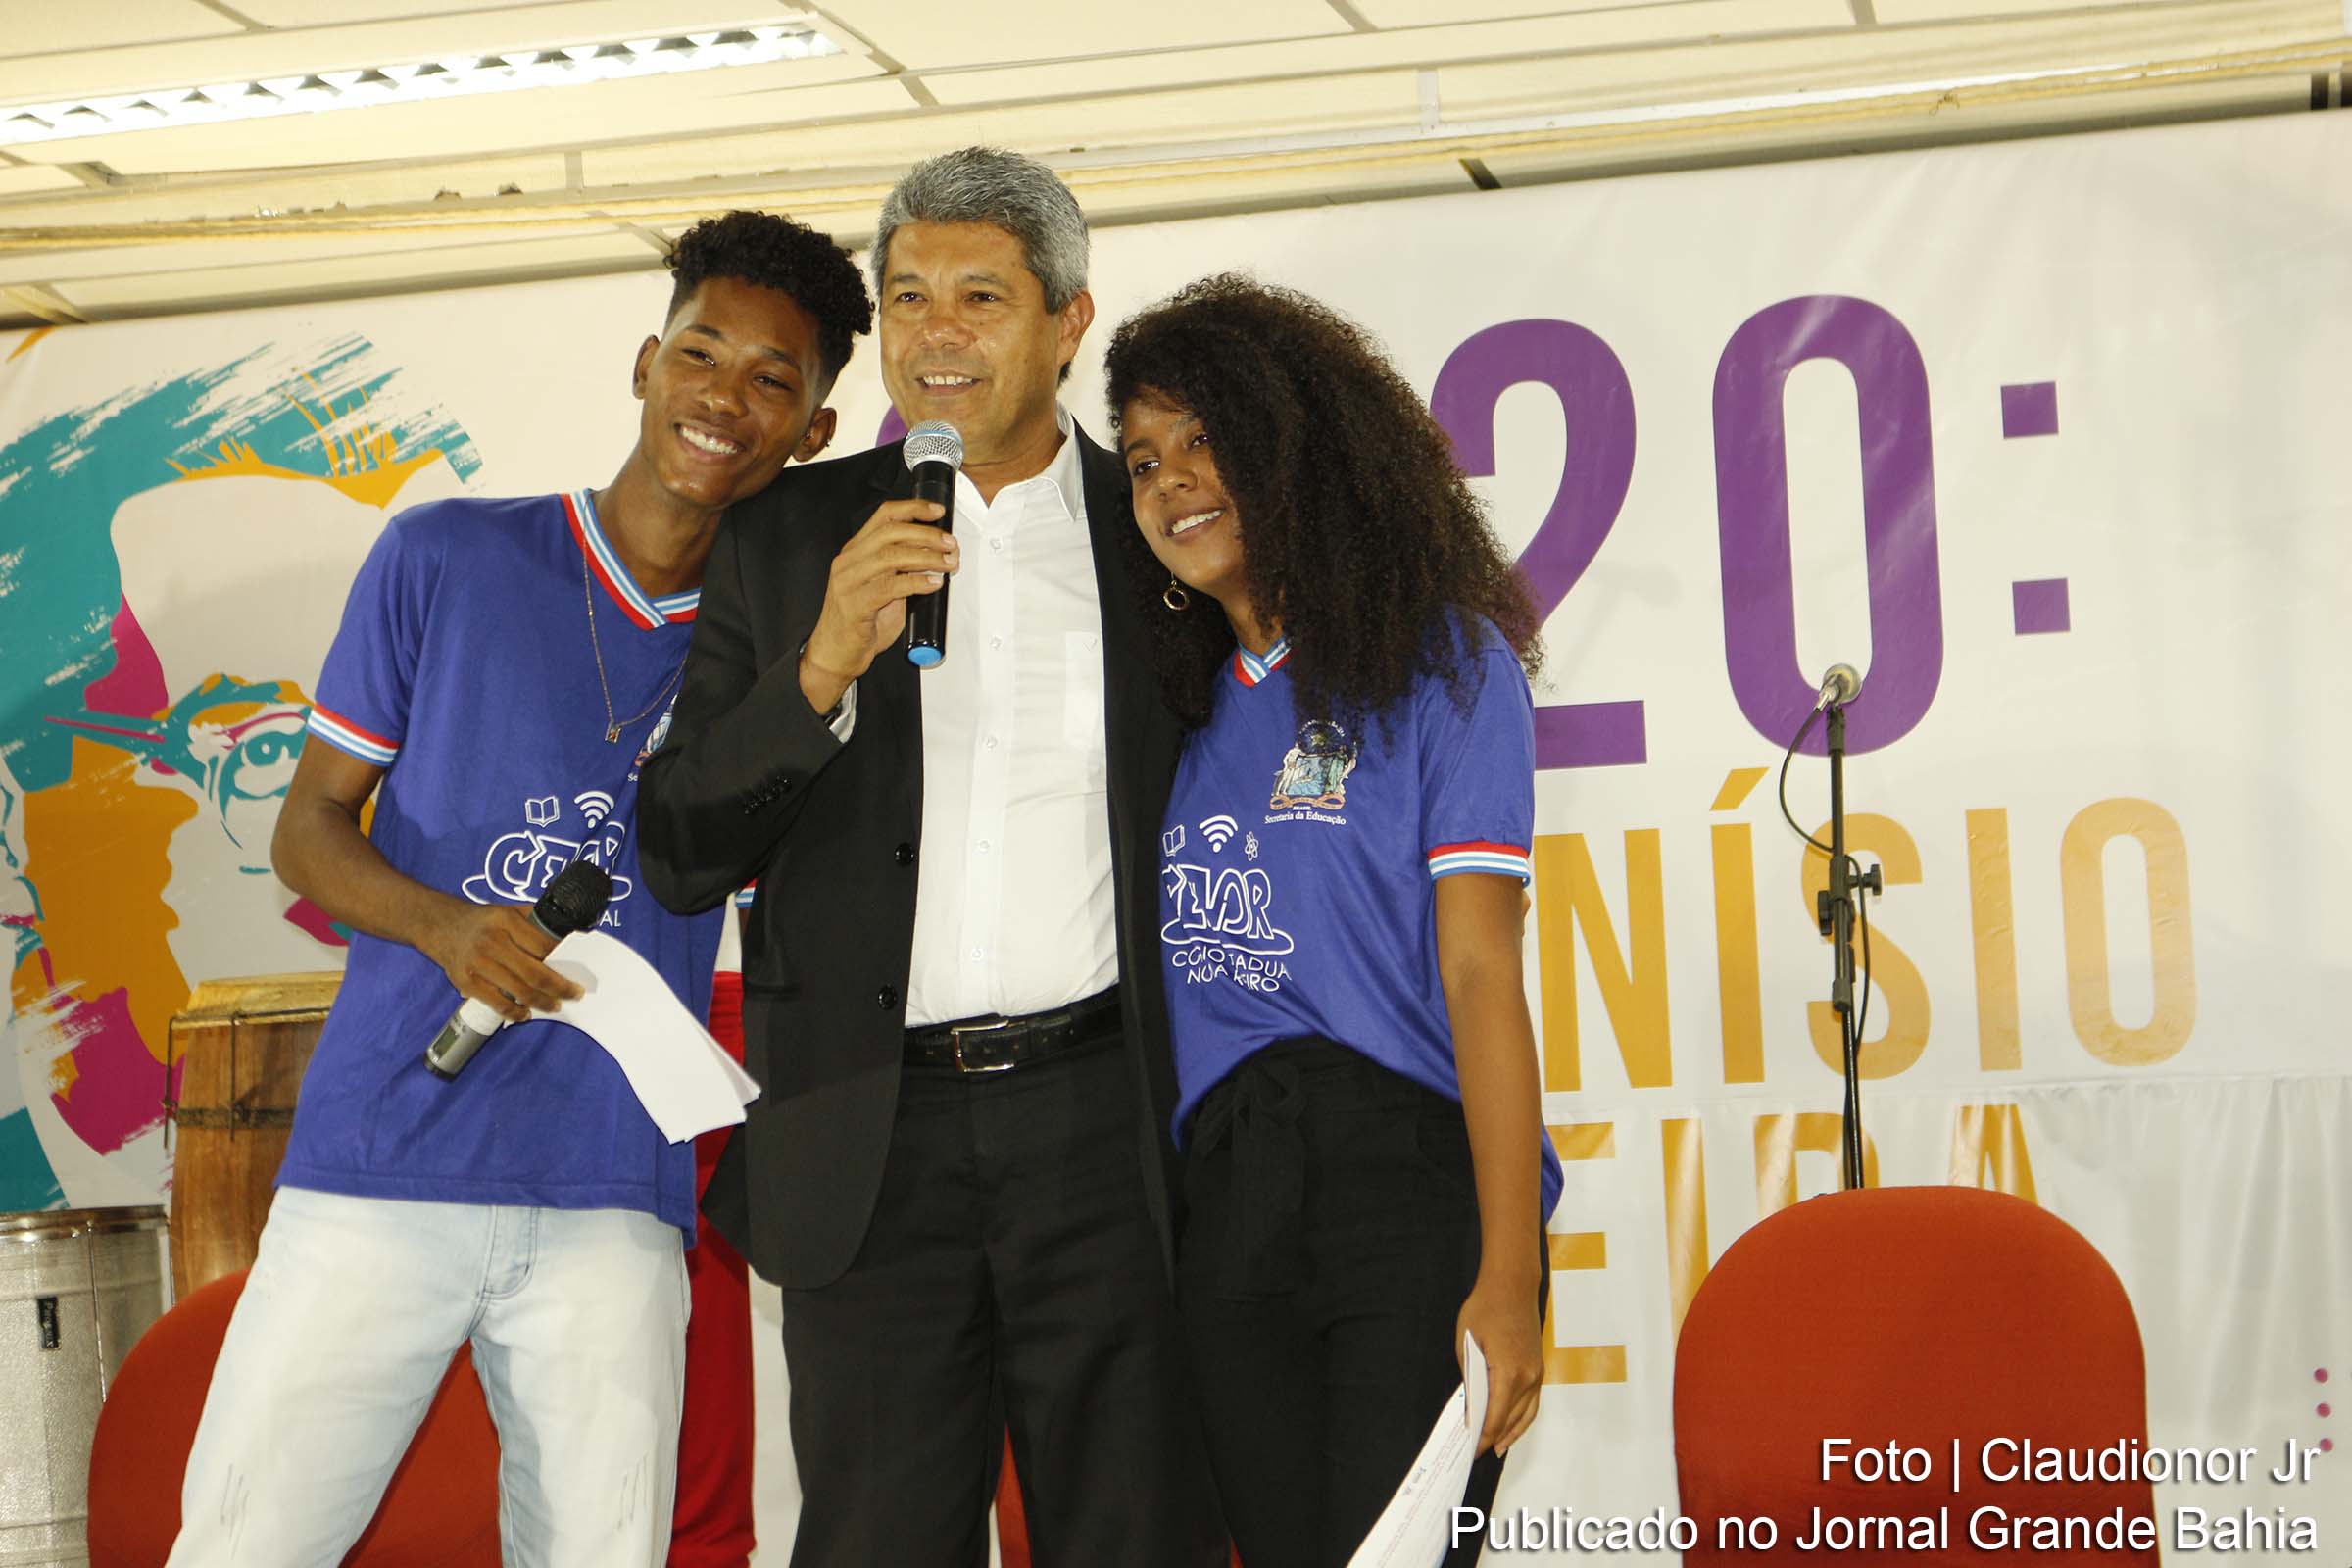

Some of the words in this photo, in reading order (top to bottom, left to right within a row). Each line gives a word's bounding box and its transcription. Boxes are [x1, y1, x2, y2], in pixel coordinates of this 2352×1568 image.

[1430, 294, 2071, 770] 20:
[1264, 811, 1294, 824] Secretaria
[1295, 812, 1304, 821] da
[1306, 811, 1347, 825] Educação
[1534, 767, 2197, 1093] NÍSIO
